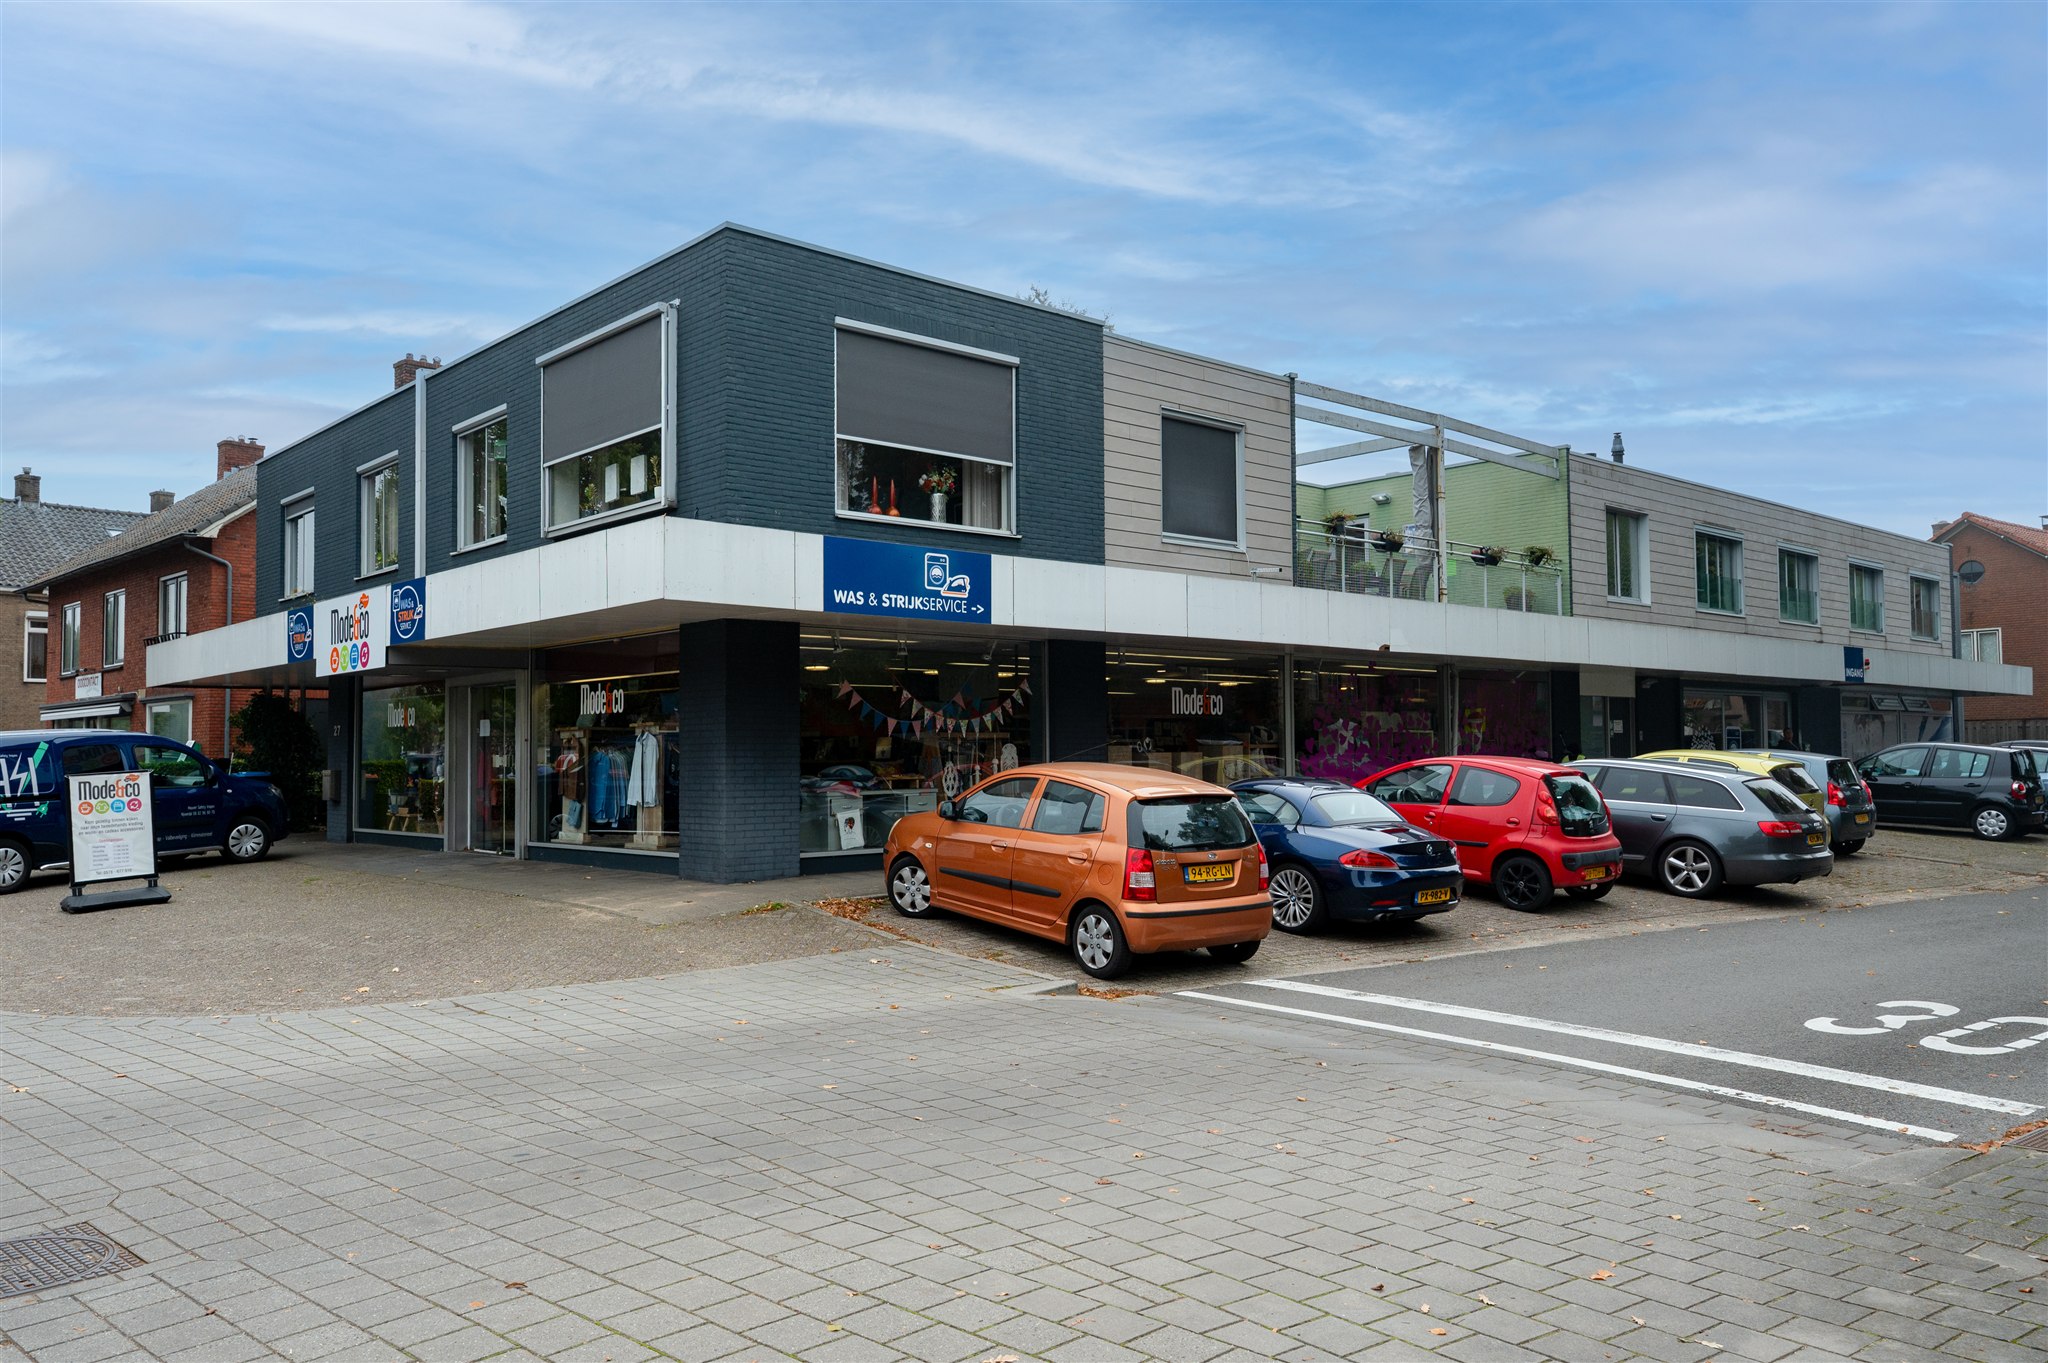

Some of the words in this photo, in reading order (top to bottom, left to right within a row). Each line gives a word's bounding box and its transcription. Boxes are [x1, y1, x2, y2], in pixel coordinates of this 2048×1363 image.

[833, 589, 864, 606] WAS
[868, 592, 879, 607] &
[881, 593, 968, 615] STRIJKSERVICE
[330, 603, 370, 645] Mode&co
[1845, 667, 1864, 678] INGANG
[580, 682, 624, 715] Mode&co
[1171, 686, 1223, 716] Mode&co
[333, 725, 341, 737] 27
[78, 779, 140, 801] Mode&co
[1191, 865, 1231, 878] 94-RG-LN
[1804, 1000, 2048, 1055] 30
